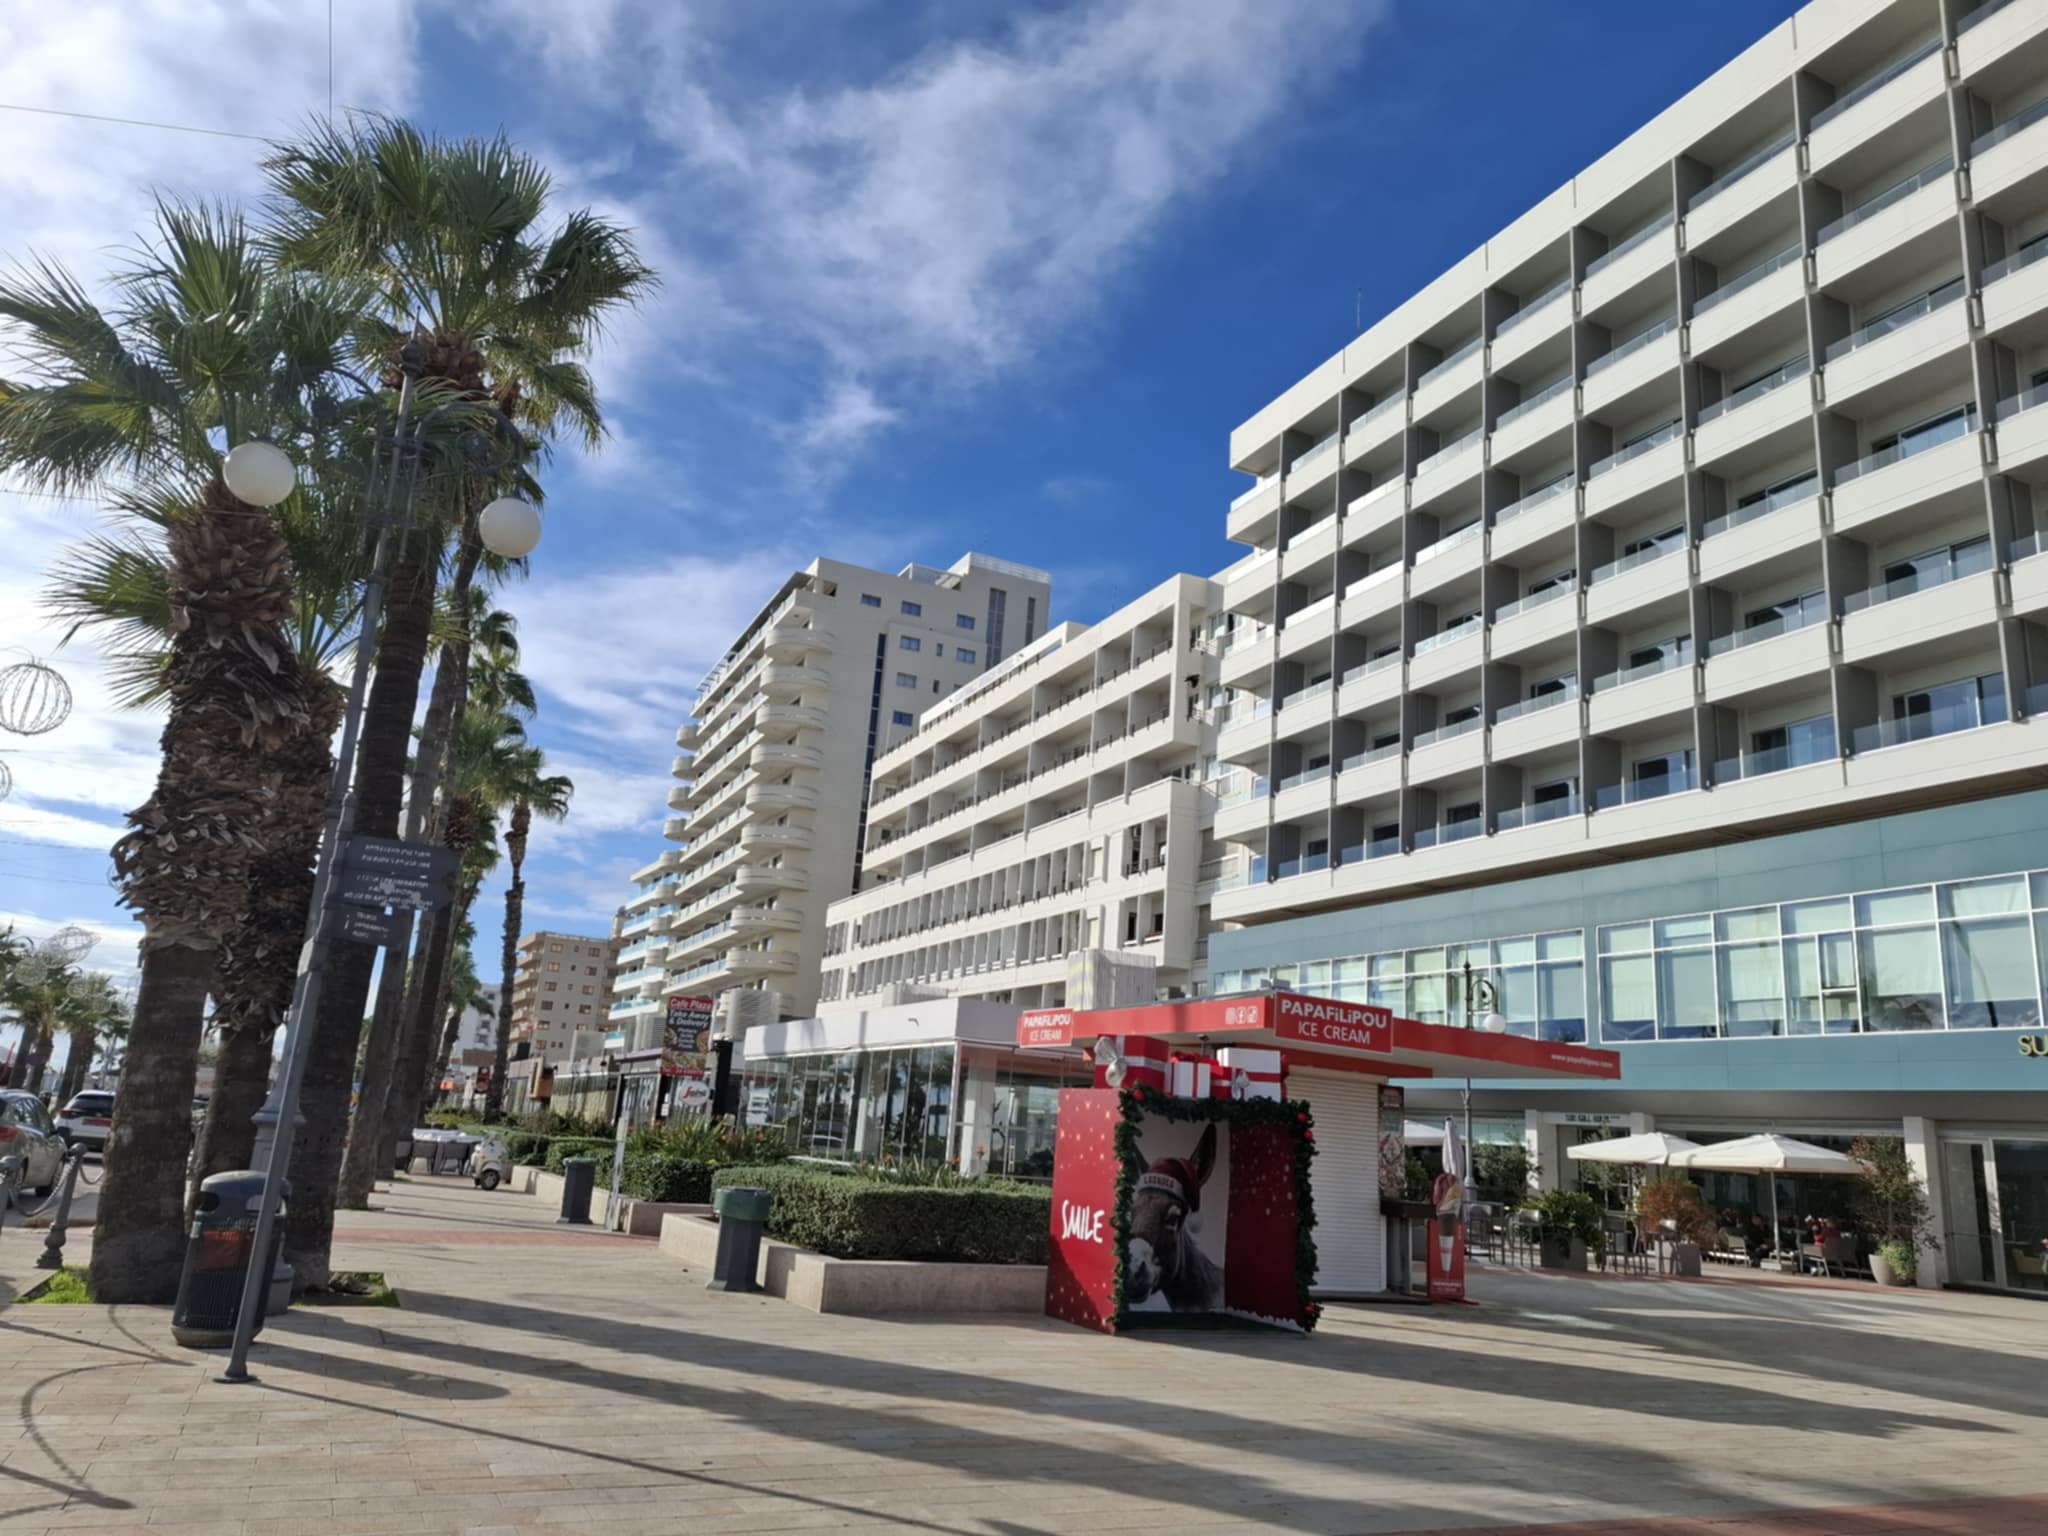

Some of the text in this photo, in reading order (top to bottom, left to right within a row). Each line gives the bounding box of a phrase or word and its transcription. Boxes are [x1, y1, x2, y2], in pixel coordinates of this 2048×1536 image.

[689, 1011, 709, 1020] Away
[676, 1019, 708, 1028] Delivery
[1030, 1030, 1062, 1041] ICE CREAM
[1298, 1021, 1371, 1045] ICE CREAM
[1062, 1200, 1105, 1243] SMILE
